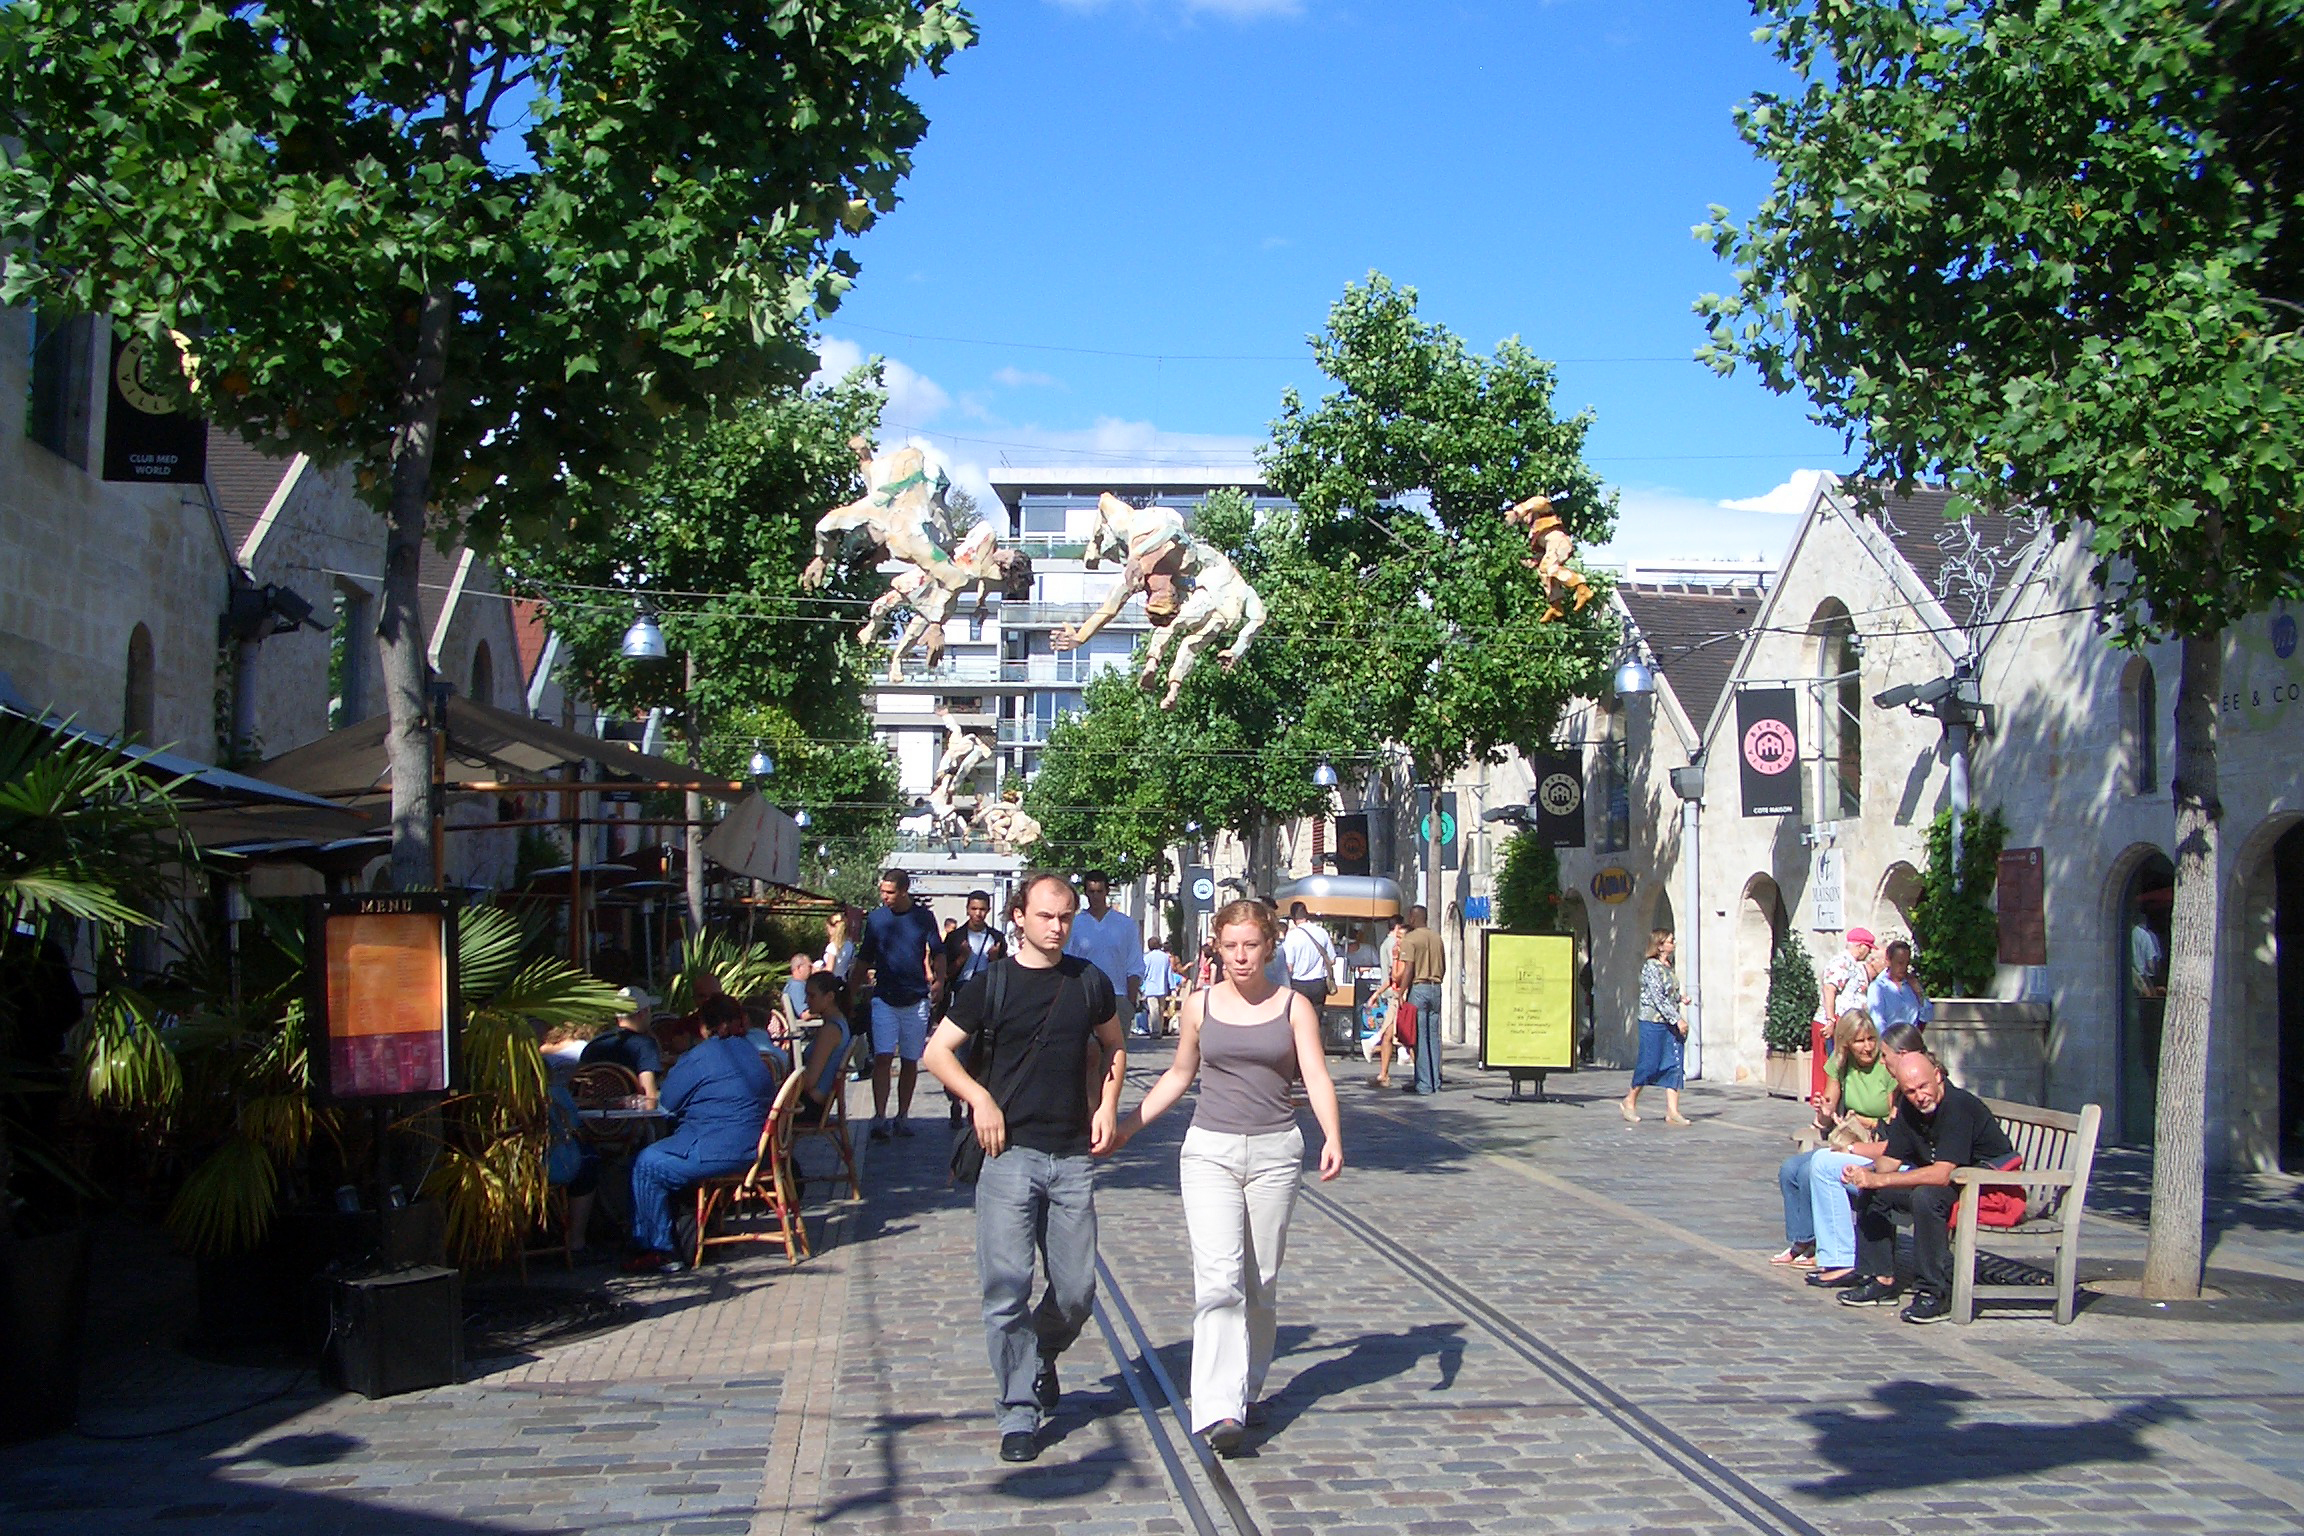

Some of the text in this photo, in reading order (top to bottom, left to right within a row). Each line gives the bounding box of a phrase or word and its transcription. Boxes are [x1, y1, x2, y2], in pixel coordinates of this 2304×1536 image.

[129, 454, 178, 464] CLUB MED
[135, 465, 171, 475] WORLD
[1750, 721, 1789, 738] BERCY
[1748, 747, 1793, 772] VILLAGE
[1769, 805, 1793, 813] MAISON
[1812, 886, 1840, 901] MAISON
[361, 899, 412, 913] MENU
